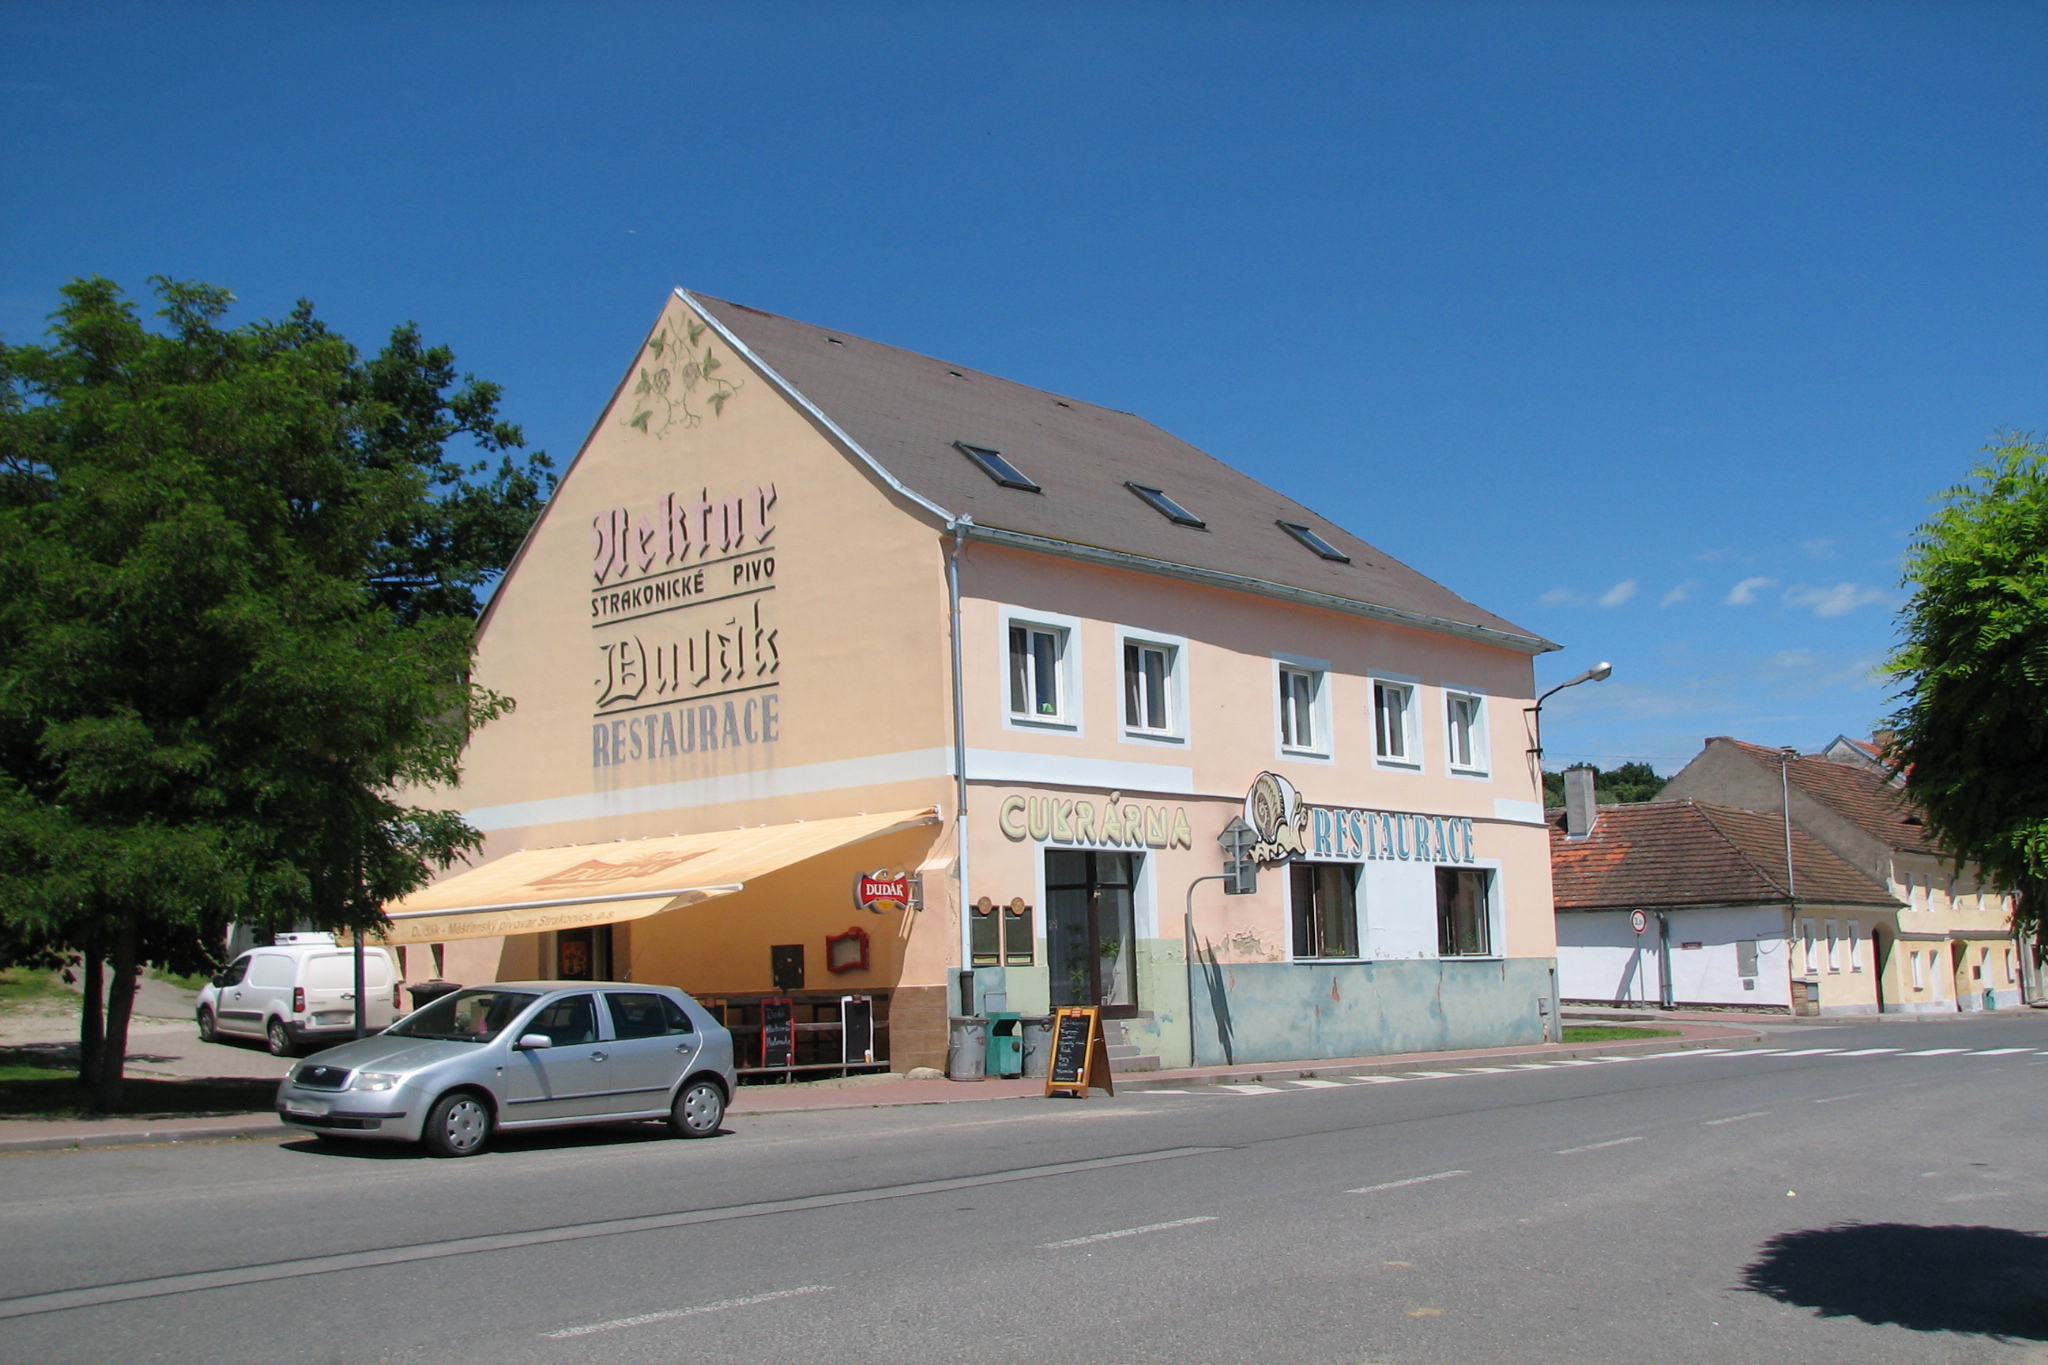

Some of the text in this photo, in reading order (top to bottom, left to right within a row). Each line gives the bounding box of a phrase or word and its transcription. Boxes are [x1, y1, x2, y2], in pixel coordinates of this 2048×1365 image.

[592, 482, 777, 585] Nektar
[592, 557, 775, 617] STRAKONICKÉ PIVO
[592, 693, 780, 767] RESTAURACE
[999, 791, 1191, 850] CUKRÁRNA
[1312, 807, 1474, 862] RESTAURACE
[866, 882, 904, 897] DUDÁK
